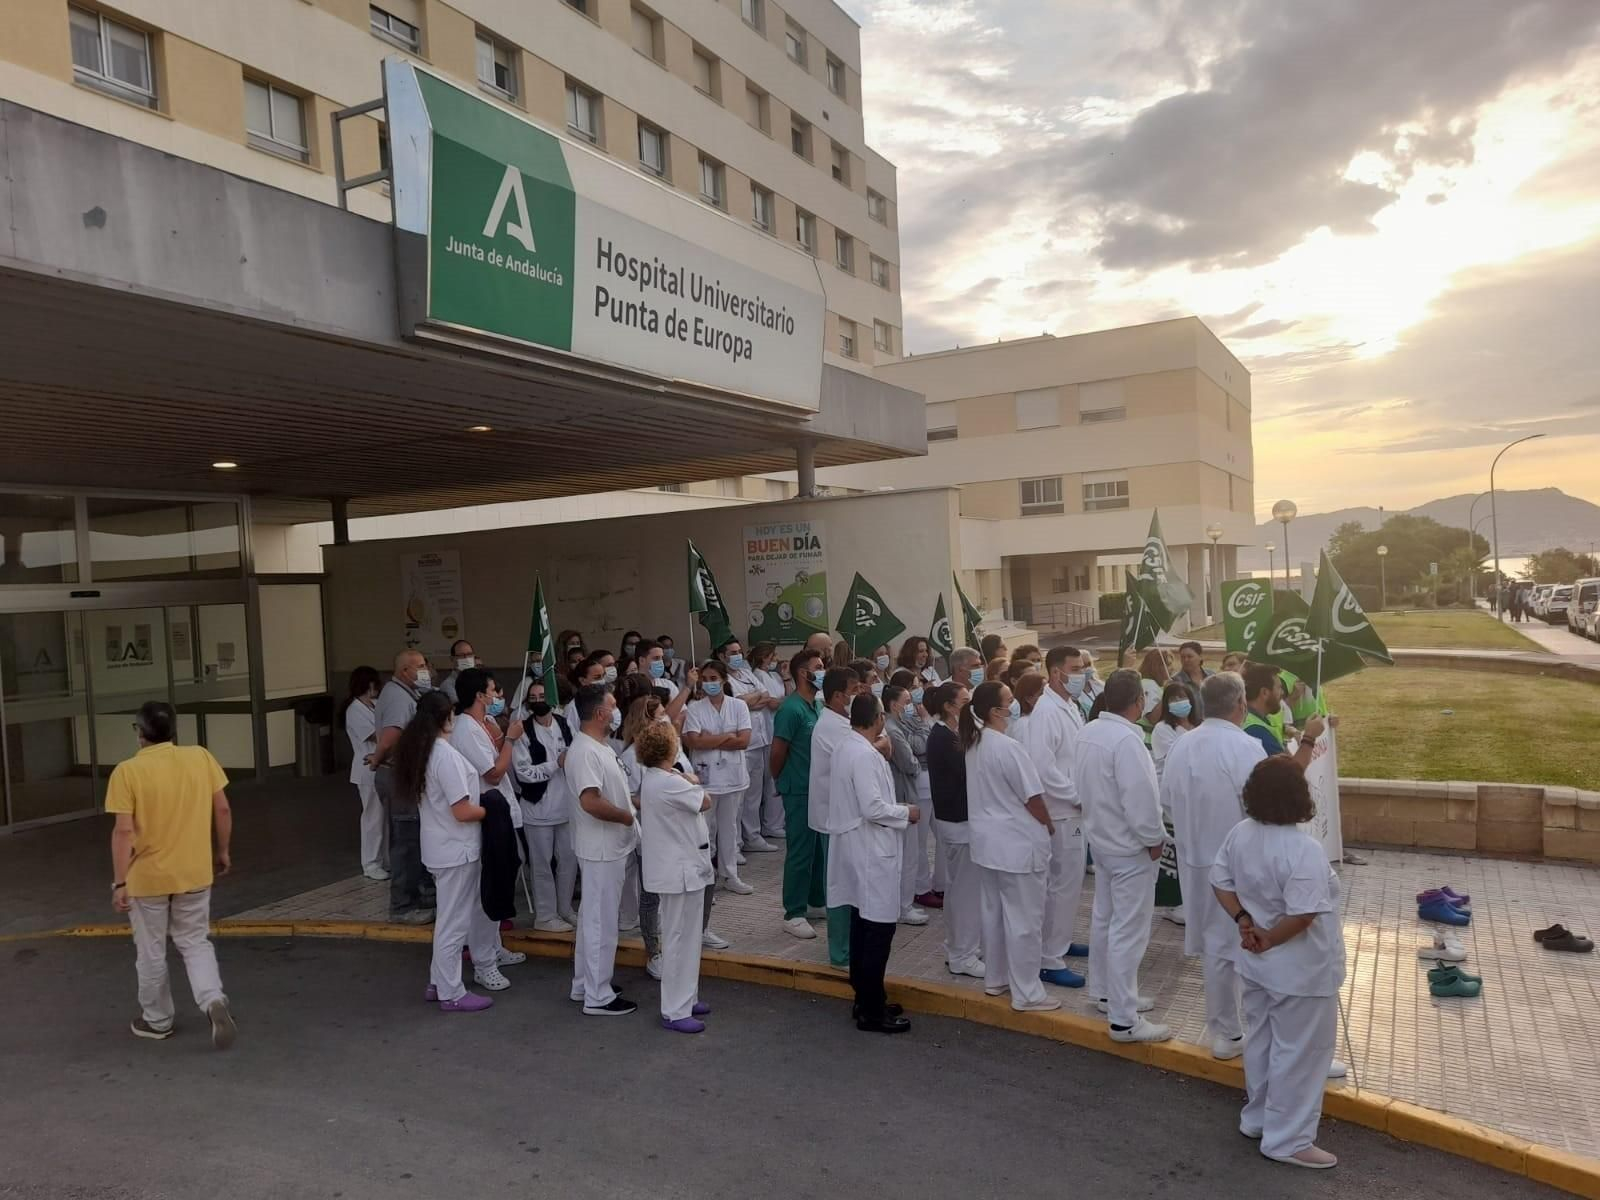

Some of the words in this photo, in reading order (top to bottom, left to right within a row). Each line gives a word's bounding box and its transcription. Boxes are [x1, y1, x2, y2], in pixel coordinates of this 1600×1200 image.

[445, 235, 485, 261] Junta
[487, 248, 504, 267] de
[505, 254, 563, 286] Andalucía
[597, 237, 685, 298] Hospital
[690, 272, 795, 336] Universitario
[595, 285, 659, 334] Punta
[665, 307, 688, 342] de
[693, 316, 753, 363] Europa
[755, 526, 777, 537] HOY
[780, 524, 793, 534] ES
[796, 522, 811, 533] UN
[747, 537, 790, 554] BUEN
[793, 532, 822, 551] DÍA
[747, 554, 766, 562] PARA
[766, 552, 788, 561] DEJAR
[799, 550, 823, 559] FUMAR
[1235, 592, 1267, 607] CSIF
